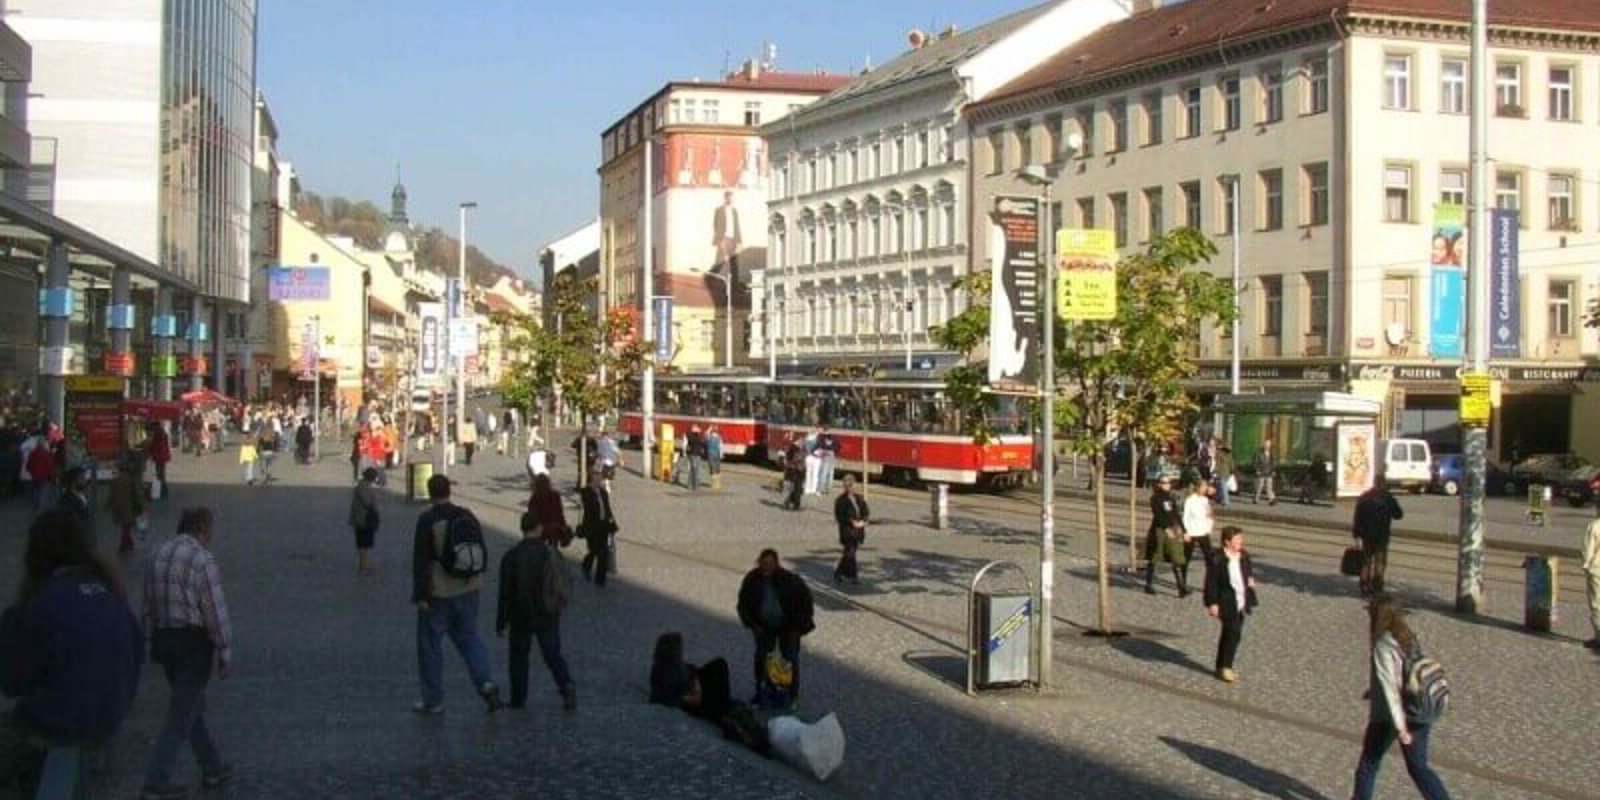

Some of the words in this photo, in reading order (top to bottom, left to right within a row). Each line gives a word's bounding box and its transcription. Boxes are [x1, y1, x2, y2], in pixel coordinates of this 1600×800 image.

[1498, 217, 1510, 255] School
[1498, 258, 1510, 320] Caledonian
[1400, 368, 1441, 378] PIZZERIA
